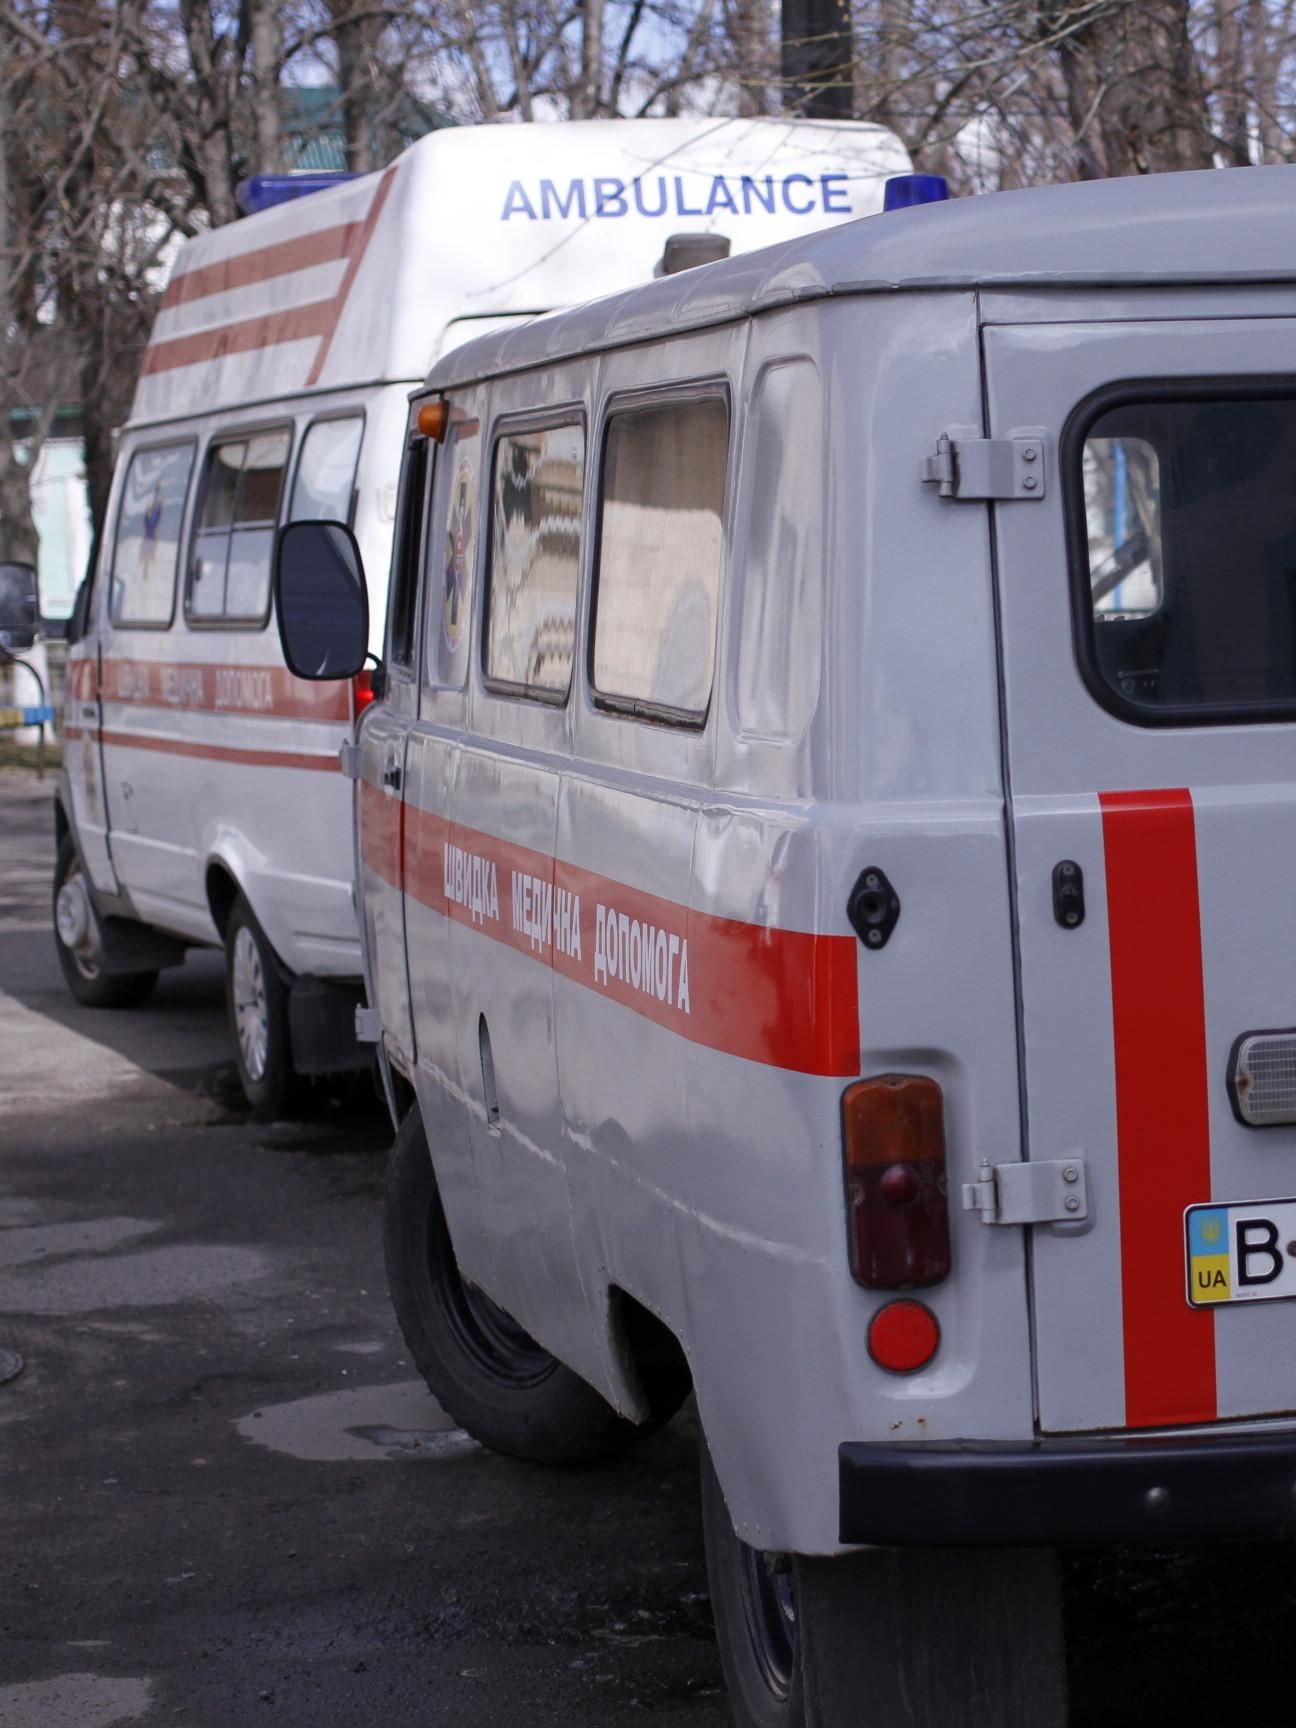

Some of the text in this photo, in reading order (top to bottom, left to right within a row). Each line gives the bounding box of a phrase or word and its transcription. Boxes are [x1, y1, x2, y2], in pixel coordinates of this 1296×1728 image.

[500, 173, 854, 221] AMBULANCE
[443, 842, 692, 1014] ШВИДКА МЕДИЧНА ДОПОМОГА
[1197, 1269, 1228, 1289] UA
